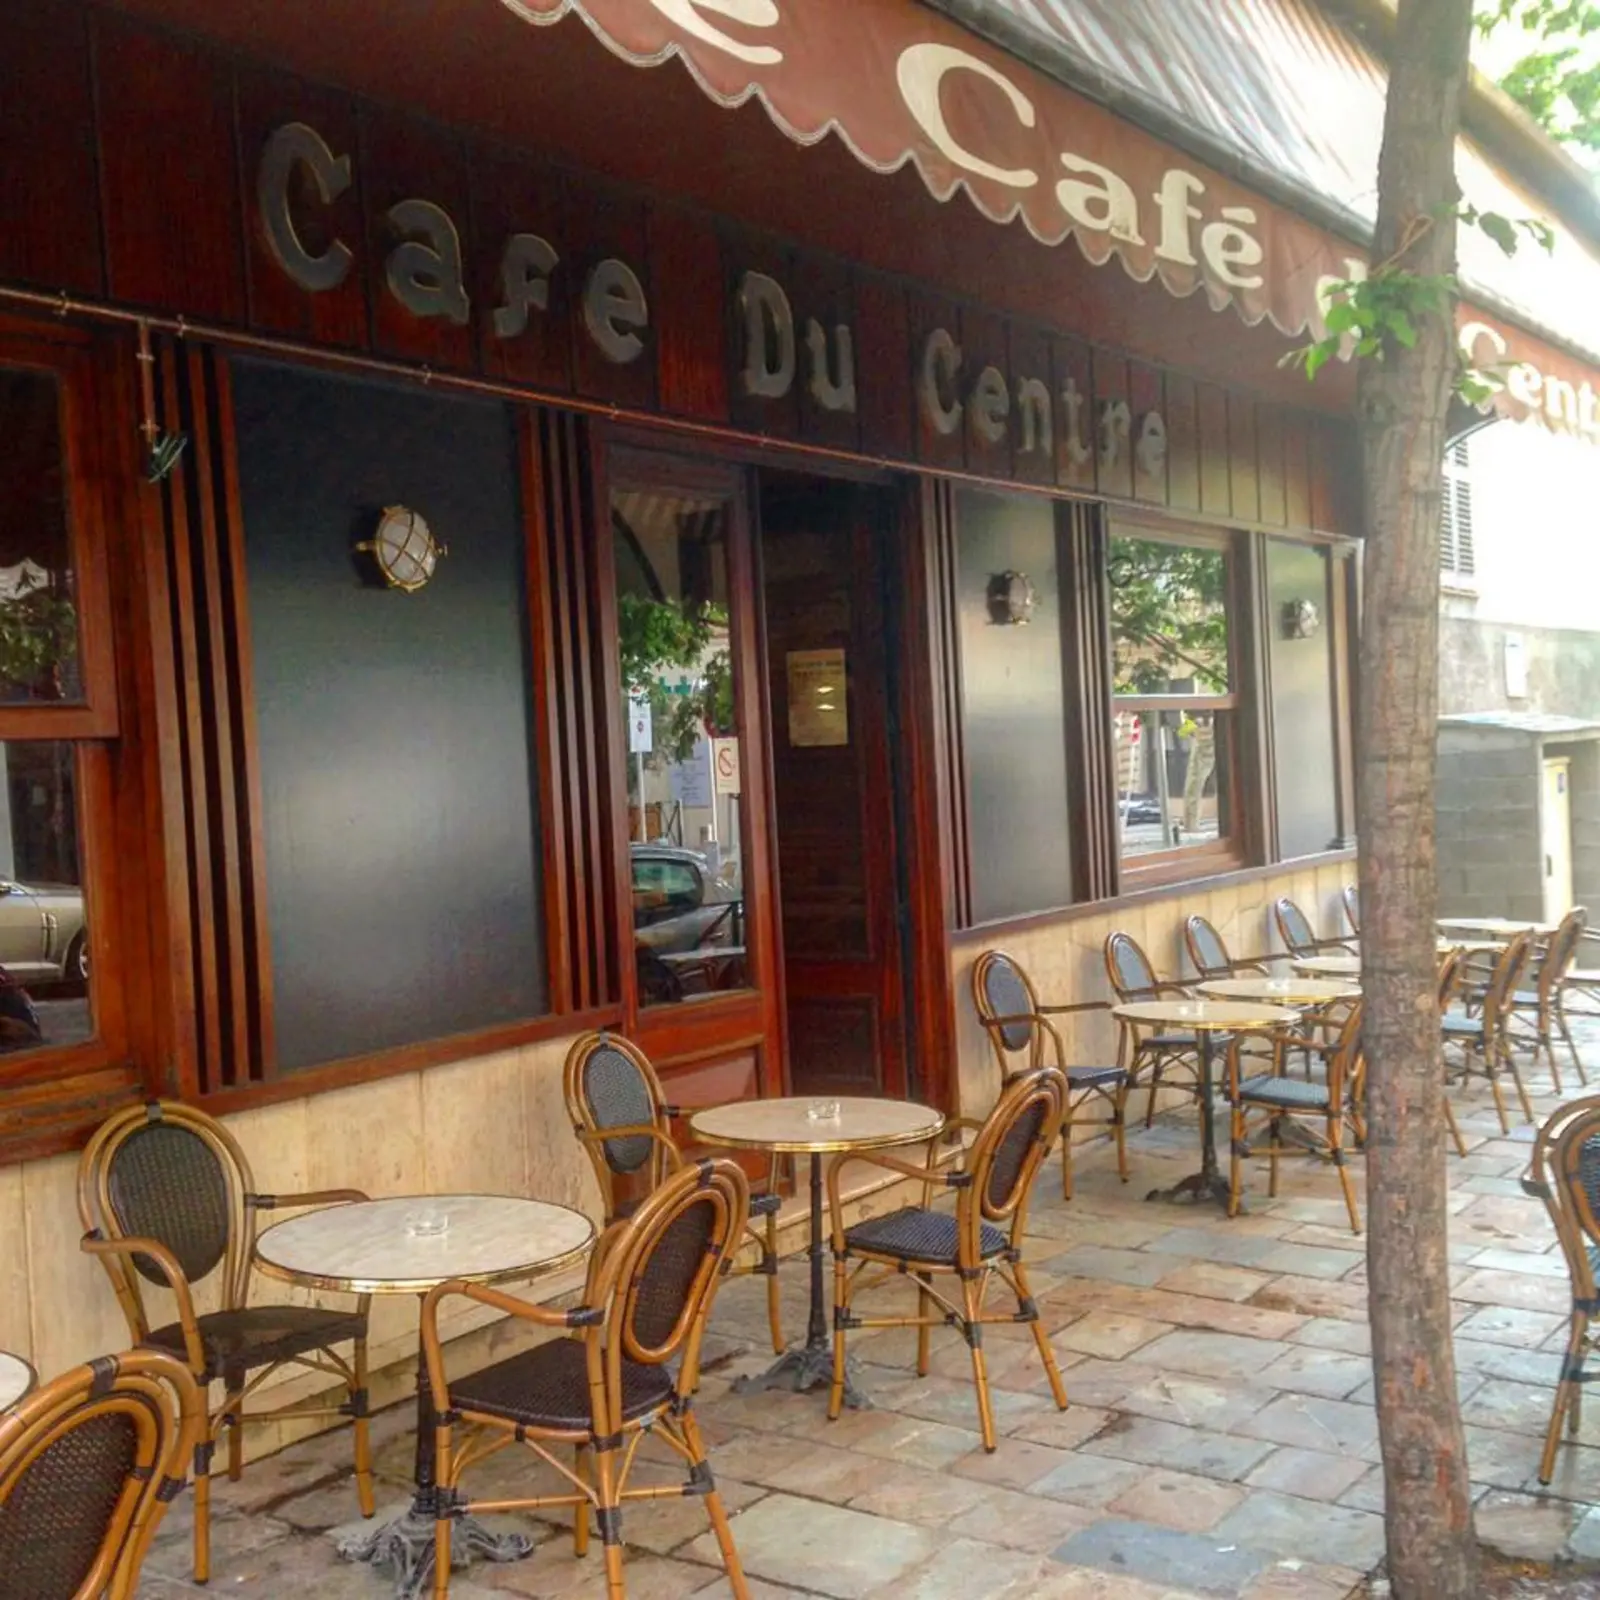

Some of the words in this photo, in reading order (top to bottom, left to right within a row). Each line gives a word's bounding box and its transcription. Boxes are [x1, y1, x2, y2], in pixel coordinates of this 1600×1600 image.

[258, 121, 648, 363] Cafe
[741, 270, 856, 413] Du
[922, 327, 1167, 476] Centre
[897, 43, 1263, 288] Café
